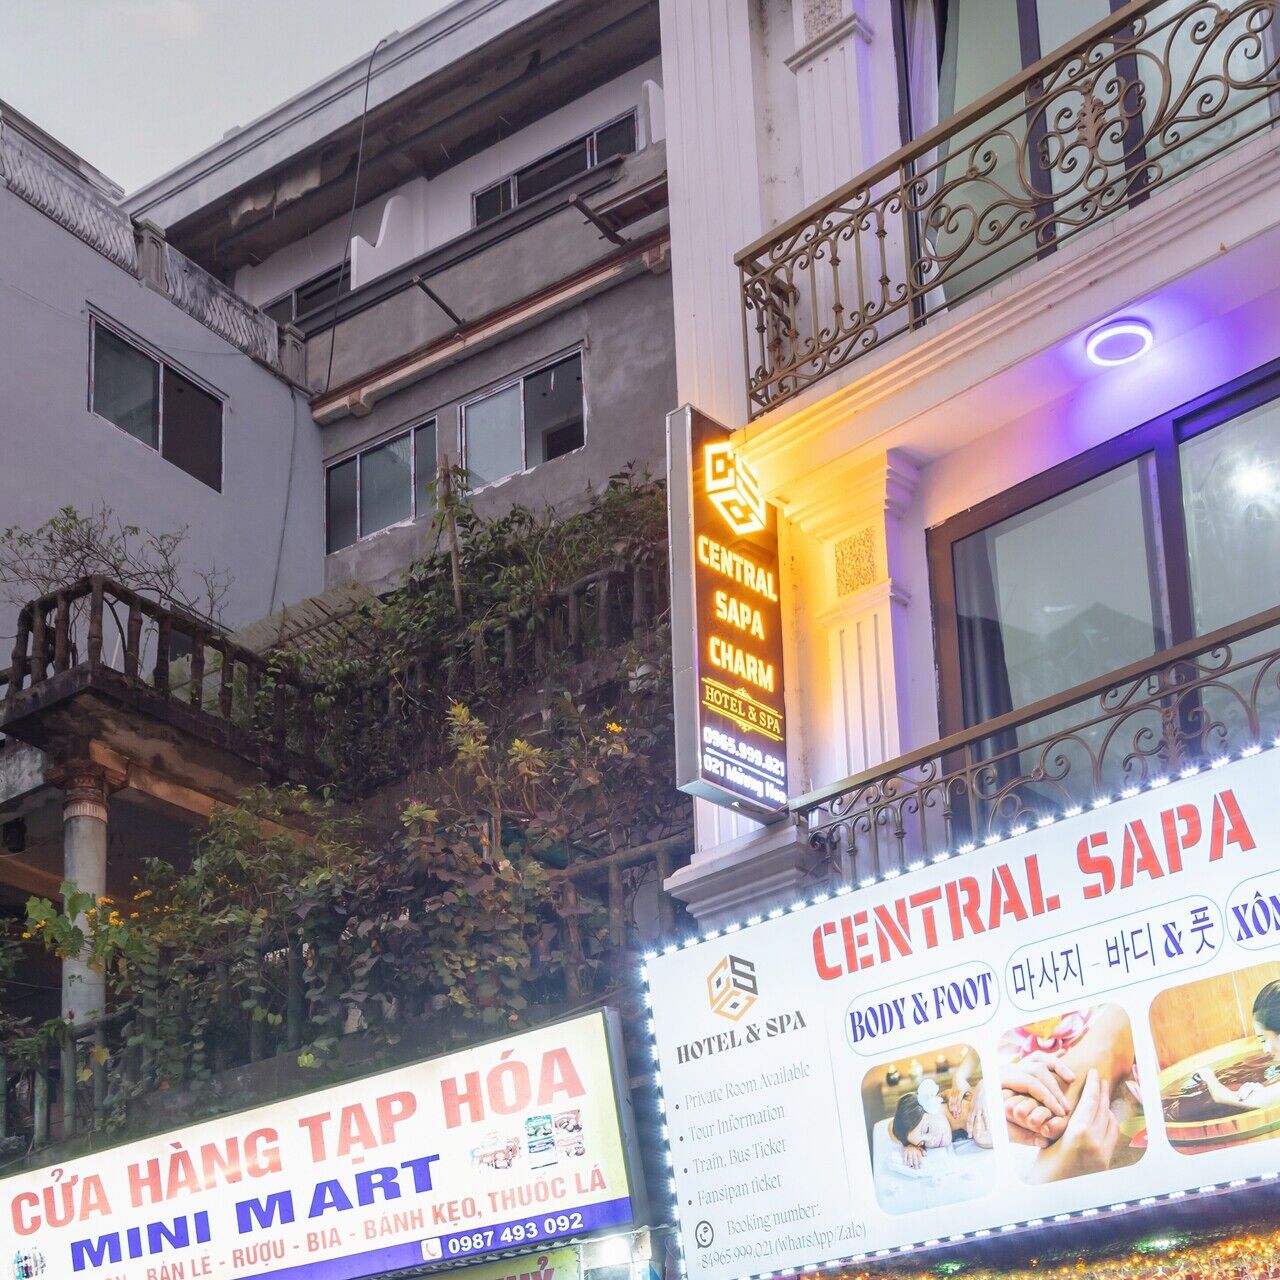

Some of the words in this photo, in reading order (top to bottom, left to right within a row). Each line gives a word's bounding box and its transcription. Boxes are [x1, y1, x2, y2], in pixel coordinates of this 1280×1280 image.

[697, 535, 778, 603] CENTRAL
[715, 590, 765, 641] SAPA
[709, 634, 774, 693] CHARM
[705, 684, 746, 718] HOTEL
[759, 708, 781, 734] SPA
[704, 753, 722, 775] 021
[812, 854, 1061, 981] CENTRAL
[1077, 788, 1256, 900] SAPA
[1012, 943, 1084, 1000] 마사지
[1105, 922, 1156, 973] 바디
[1163, 921, 1183, 959] &
[1190, 905, 1216, 955] 풋
[849, 996, 906, 1043] BODY
[912, 991, 930, 1026] &
[932, 971, 992, 1020] FOOT
[676, 1030, 742, 1065] HOTEL
[746, 1023, 762, 1043] &
[766, 1010, 807, 1038] SPA
[685, 1085, 724, 1111] Private
[725, 1080, 757, 1100] Room
[758, 1061, 812, 1091] Available
[11, 1168, 113, 1236] CỬA
[127, 1127, 283, 1208] HÀNG
[299, 1091, 417, 1164] TẠP
[440, 1047, 587, 1129] HÓA
[689, 1123, 714, 1143] Tour
[716, 1103, 786, 1135] Information
[729, 1148, 750, 1165] Bus
[751, 1136, 787, 1160] Ticket
[71, 1210, 212, 1272] MINI
[235, 1153, 441, 1235] MART
[697, 1183, 750, 1207] Fansipan
[751, 1172, 782, 1195] ticket
[232, 1238, 286, 1269] RƯỢU
[307, 1226, 342, 1254] BIA
[363, 1208, 425, 1241] BÁNH
[432, 1197, 482, 1229] KẸO,
[488, 1172, 567, 1215] THUỐC
[575, 1164, 608, 1195] LÁ
[448, 1230, 495, 1255] 0987
[500, 1220, 538, 1243] 493
[544, 1211, 584, 1235] 092
[727, 1212, 771, 1236] Booking
[773, 1202, 821, 1224] number:
